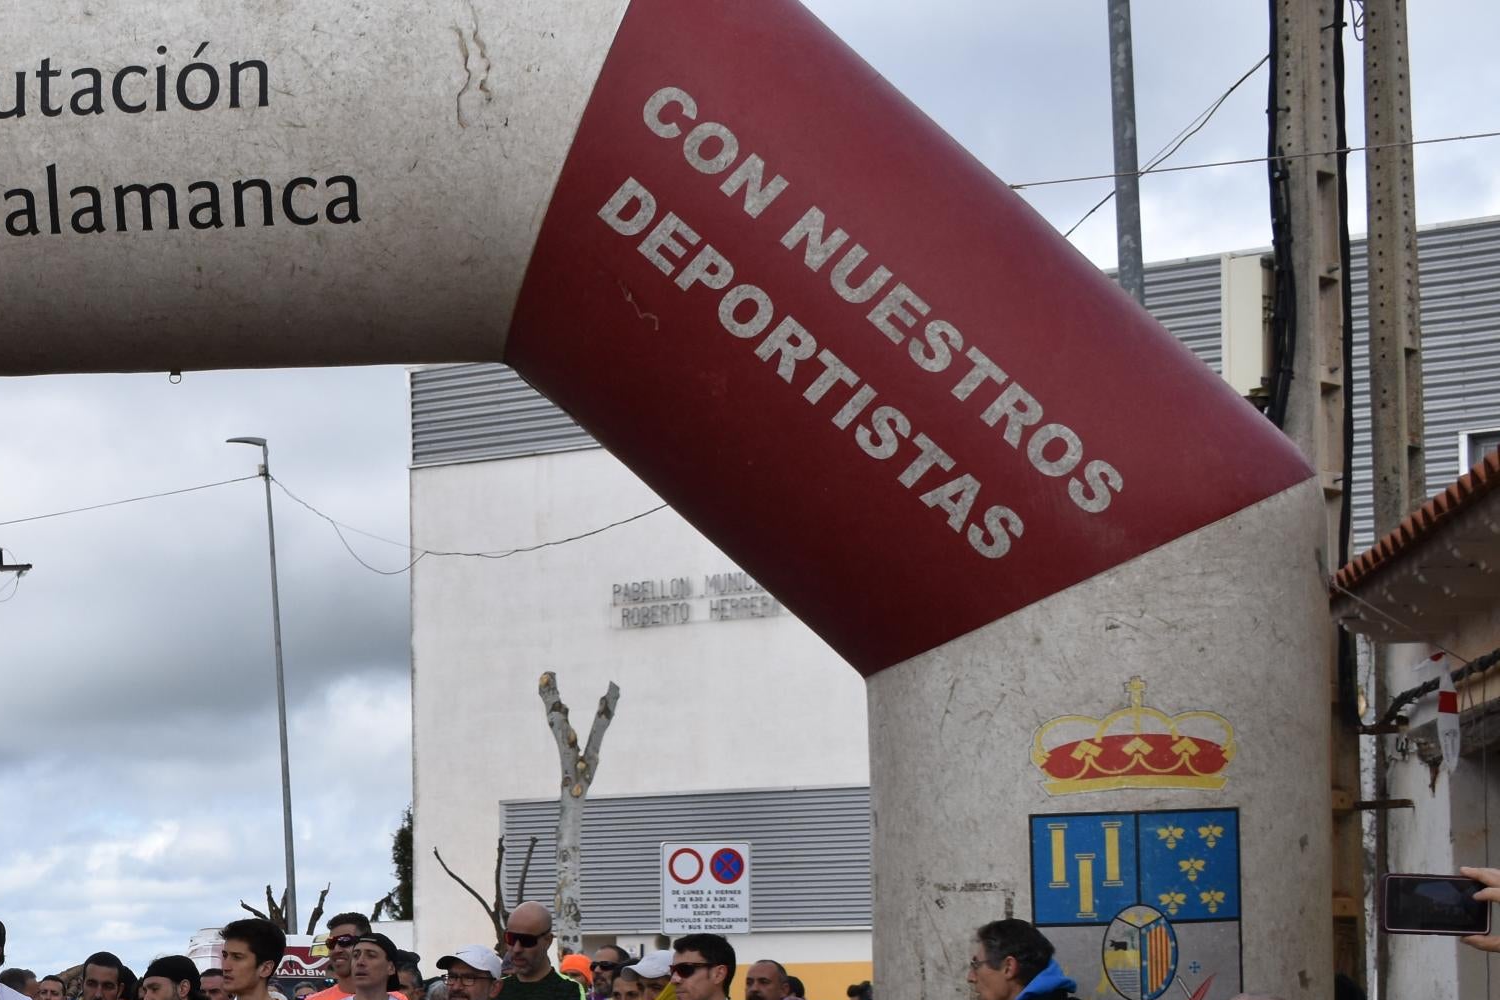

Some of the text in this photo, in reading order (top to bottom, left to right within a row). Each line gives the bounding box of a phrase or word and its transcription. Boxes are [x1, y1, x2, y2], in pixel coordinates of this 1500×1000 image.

[597, 176, 1025, 560] DEPORTISTAS
[642, 86, 1125, 515] CON NUESTROS
[621, 602, 691, 628] ROBERTO
[705, 571, 764, 596] MUNIC
